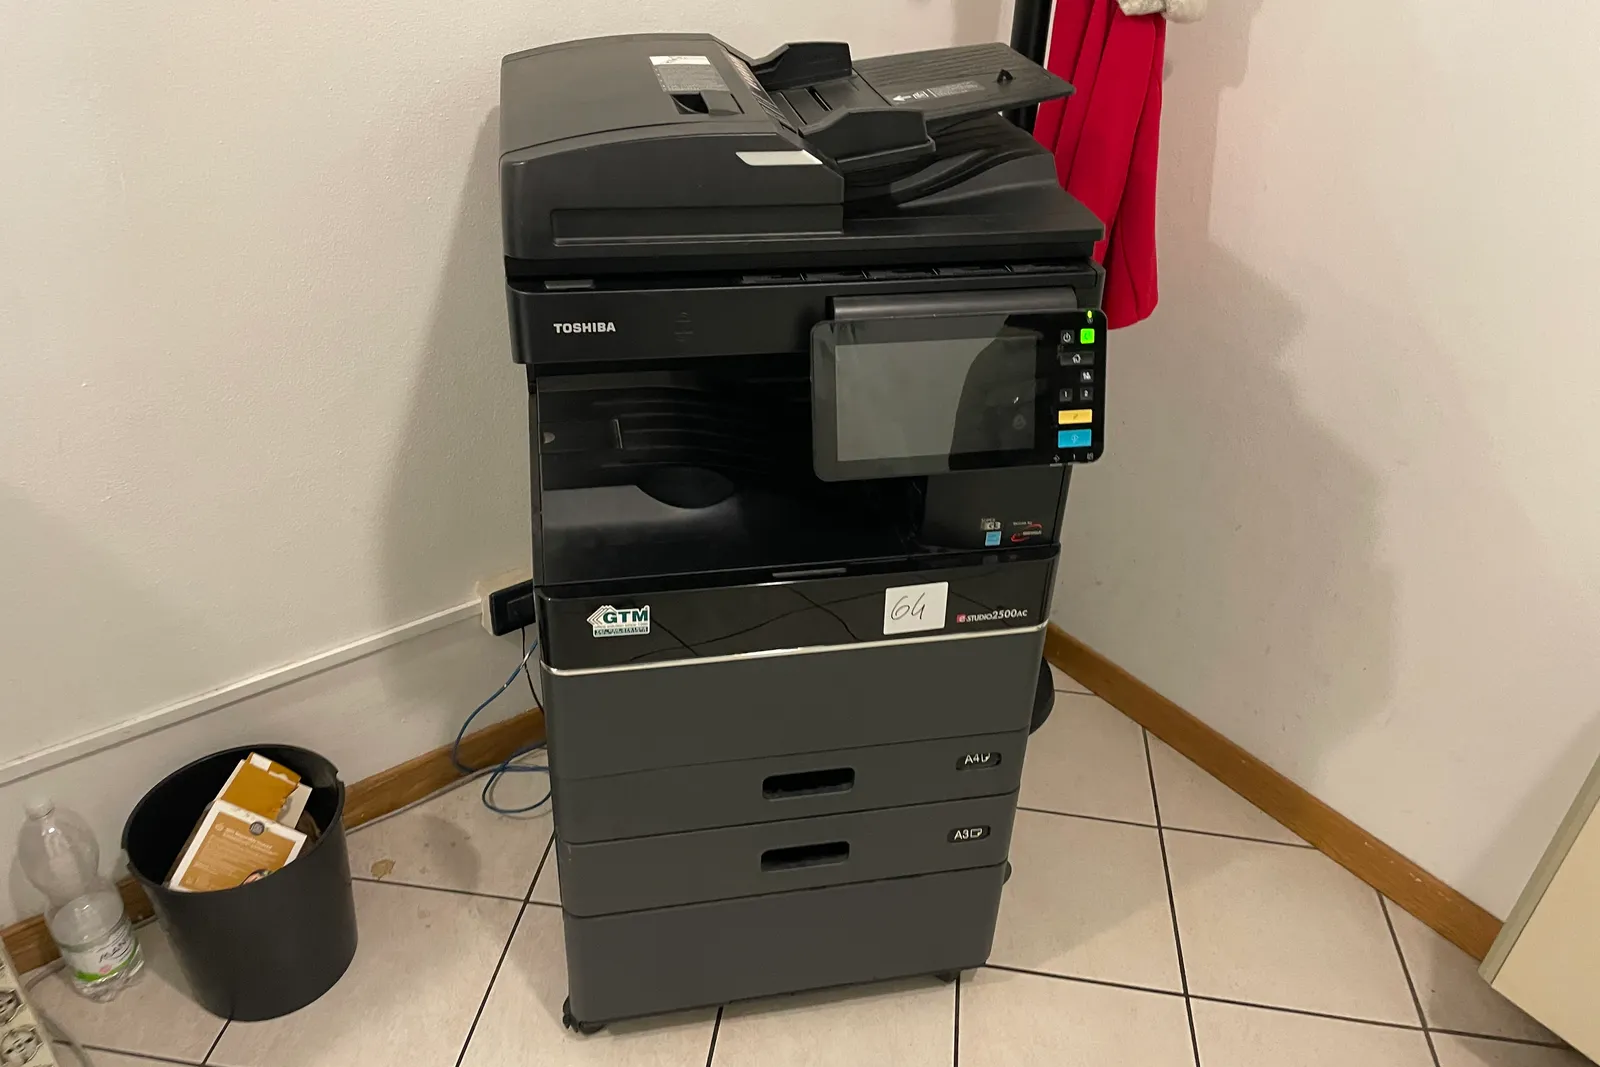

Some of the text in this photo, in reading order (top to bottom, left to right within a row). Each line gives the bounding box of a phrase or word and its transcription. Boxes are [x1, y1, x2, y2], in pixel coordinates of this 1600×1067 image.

[553, 321, 616, 334] TOSHIBA
[890, 592, 926, 621] 64
[603, 610, 648, 624] GTM
[964, 753, 979, 765] A4
[954, 829, 969, 841] A3
